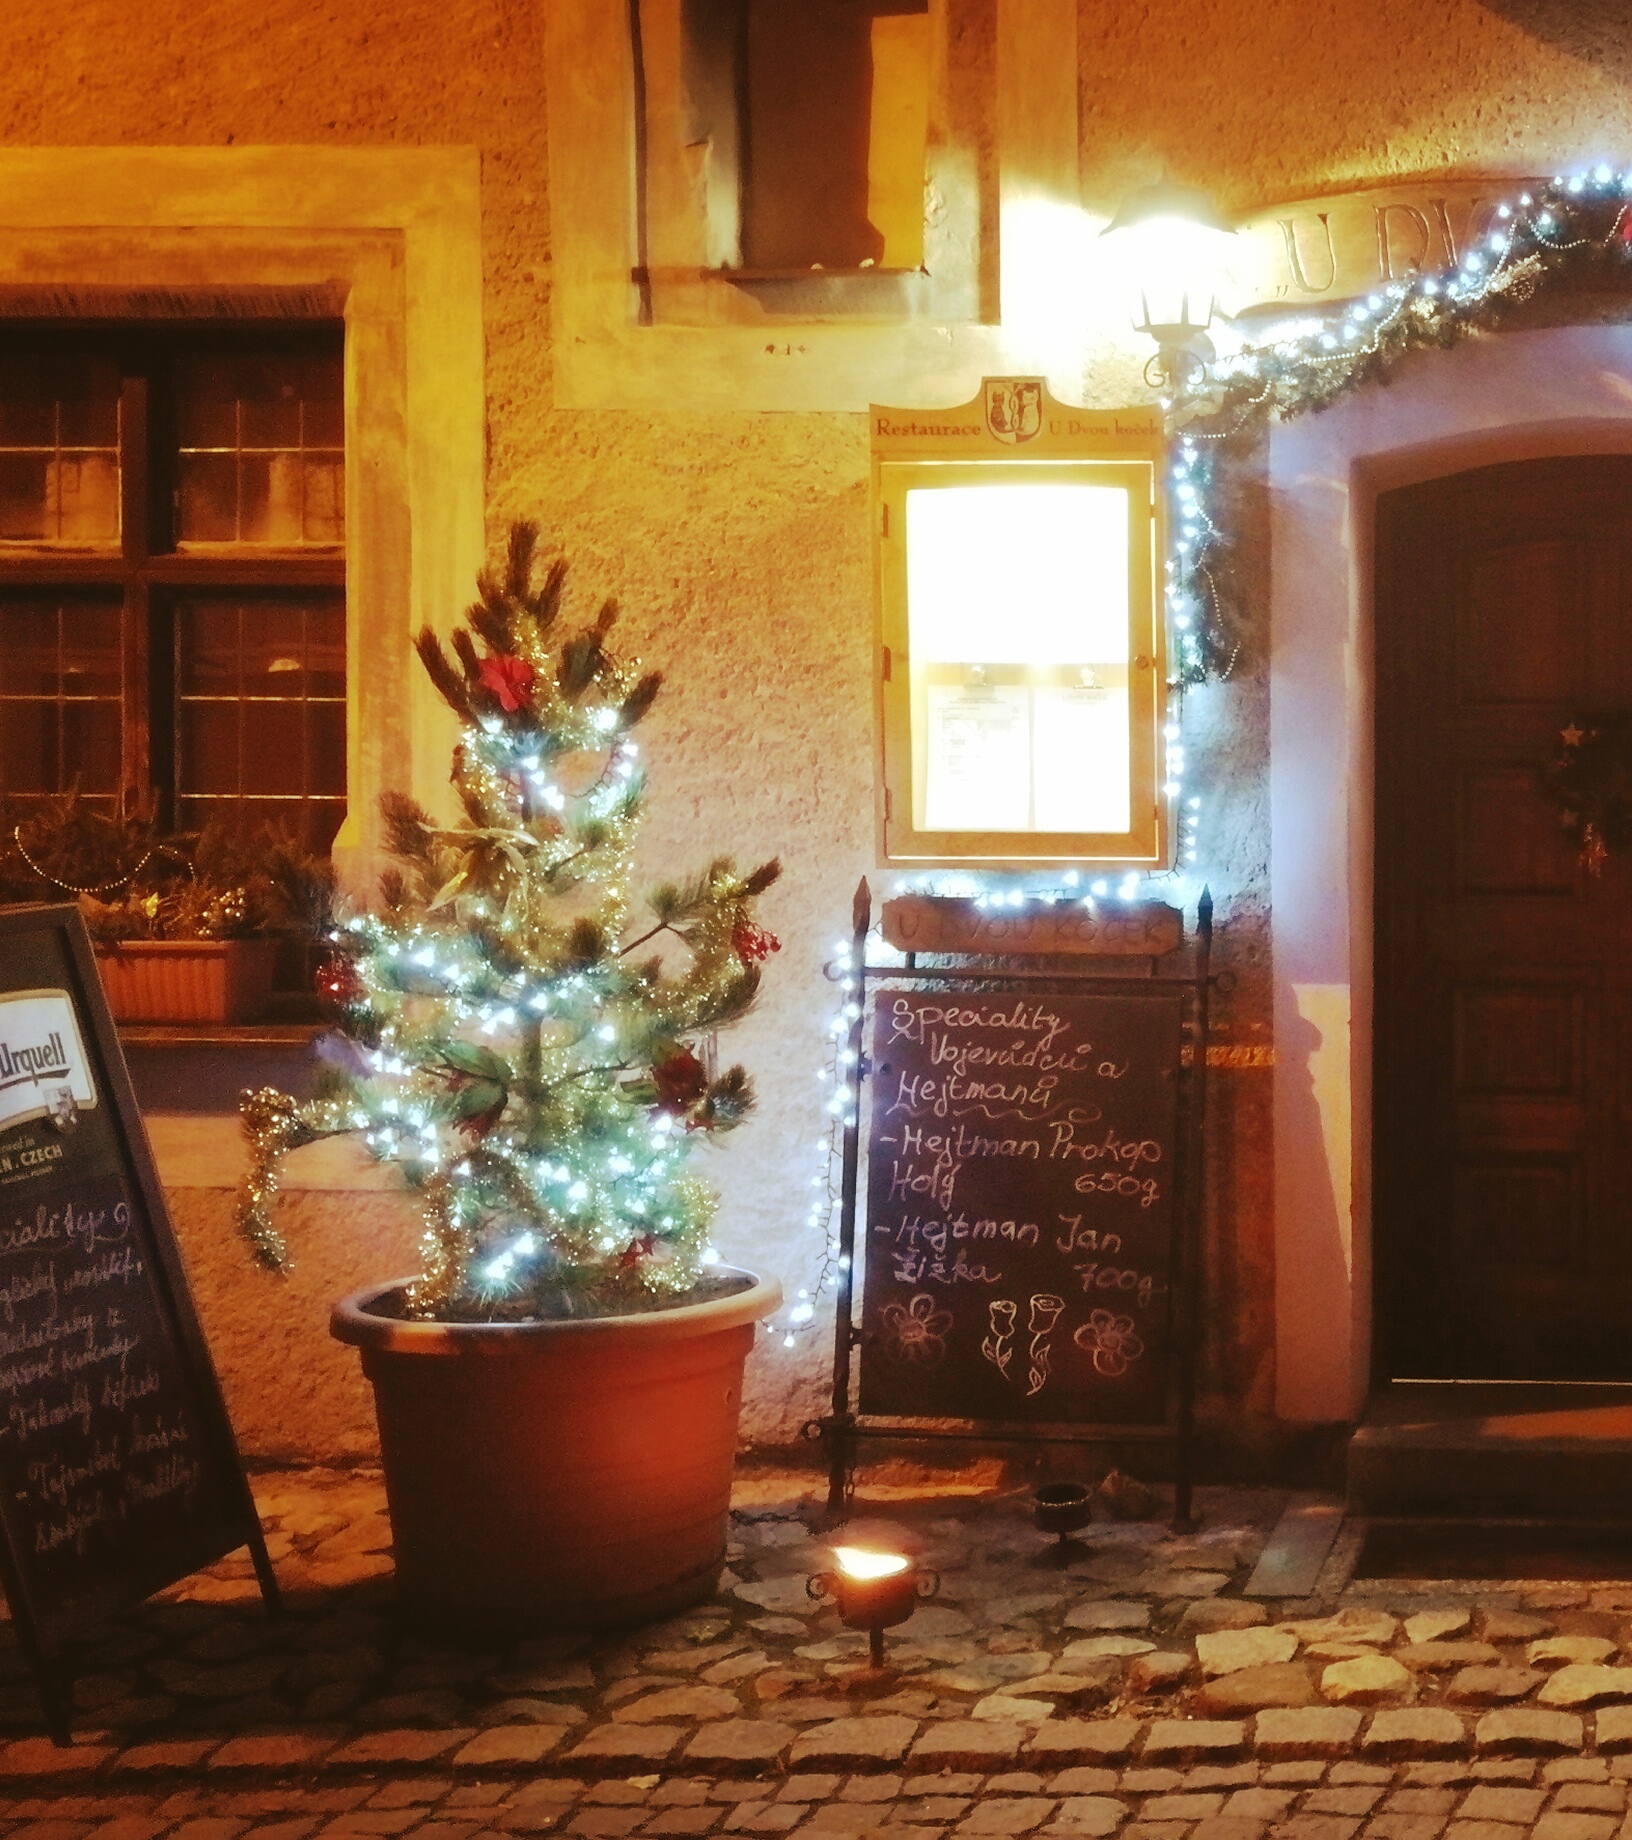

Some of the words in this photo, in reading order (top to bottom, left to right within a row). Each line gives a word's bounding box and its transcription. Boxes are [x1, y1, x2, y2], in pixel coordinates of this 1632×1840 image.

[876, 418, 982, 437] Restaurace
[887, 998, 1070, 1045] Speciality
[1097, 1060, 1130, 1079] a
[20, 1144, 64, 1168] CZECH
[1049, 1120, 1162, 1171] Prokop
[887, 1159, 961, 1211] Holý
[1074, 1171, 1161, 1208] 650g
[1056, 1213, 1122, 1254] Jan
